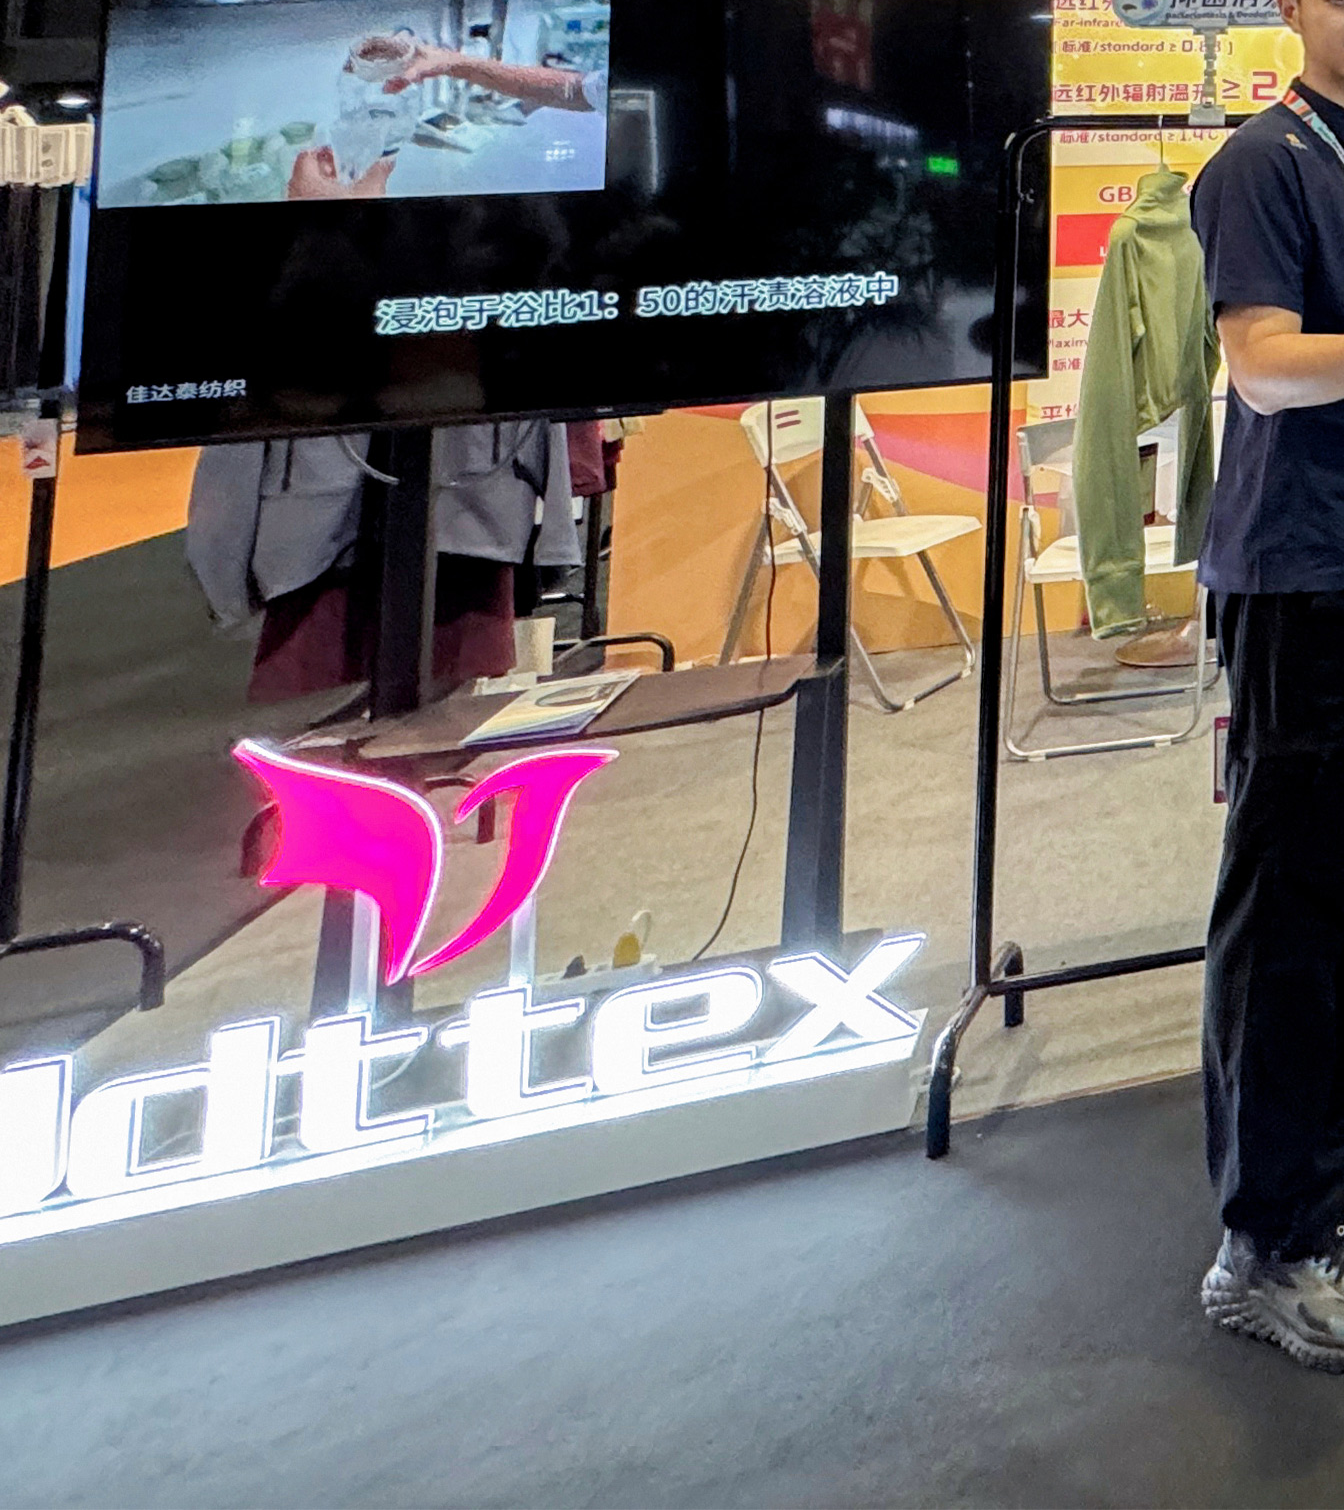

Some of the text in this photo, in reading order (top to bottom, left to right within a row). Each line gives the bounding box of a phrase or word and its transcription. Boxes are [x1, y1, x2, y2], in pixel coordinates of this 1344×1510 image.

[1099, 186, 1133, 203] GB
[125, 376, 248, 406] 佳达泰纺织
